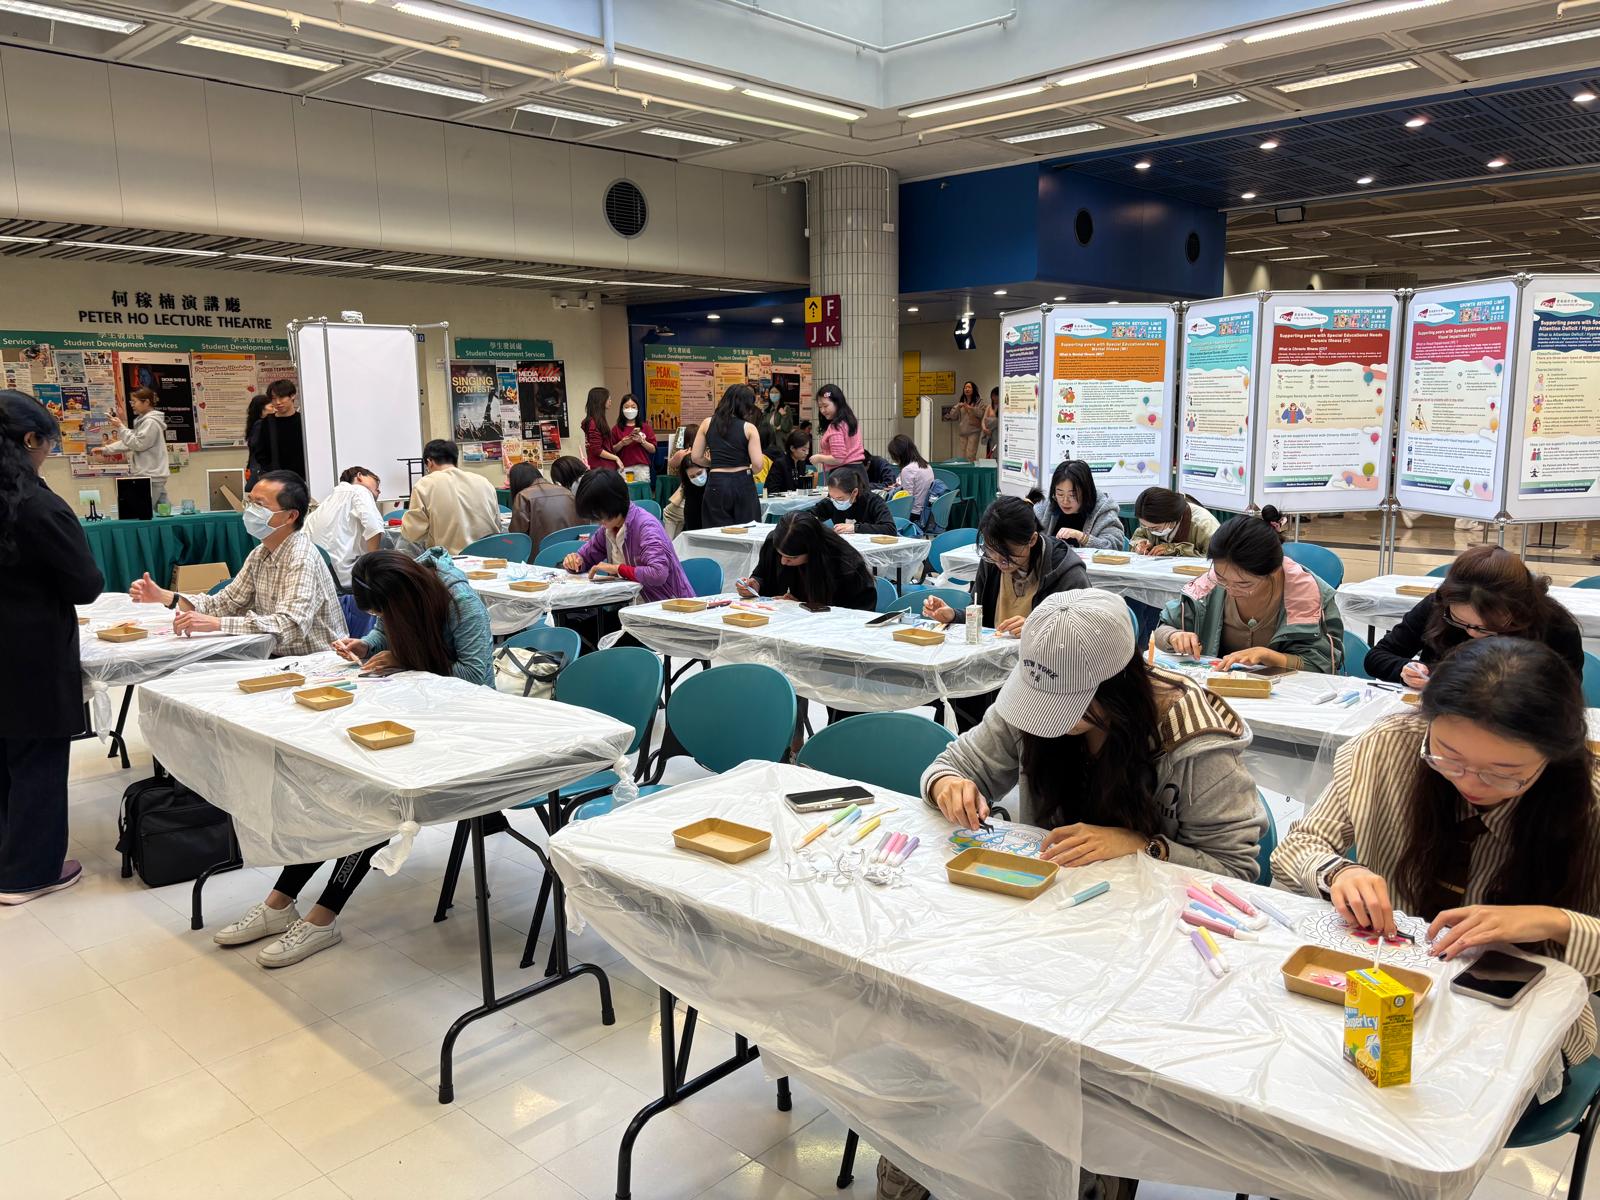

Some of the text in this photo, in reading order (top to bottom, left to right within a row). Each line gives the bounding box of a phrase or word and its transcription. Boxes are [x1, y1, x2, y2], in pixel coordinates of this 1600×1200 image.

[112, 290, 241, 313] 何稼楠演講廳
[827, 300, 834, 316] F
[78, 310, 272, 329] PETER HO LECTURE THEATRE
[811, 326, 836, 343] J K
[656, 366, 670, 378] PEAK
[452, 376, 493, 386] SINGING
[650, 379, 678, 388] PERFORMANCE
[1037, 663, 1058, 680] YORK
